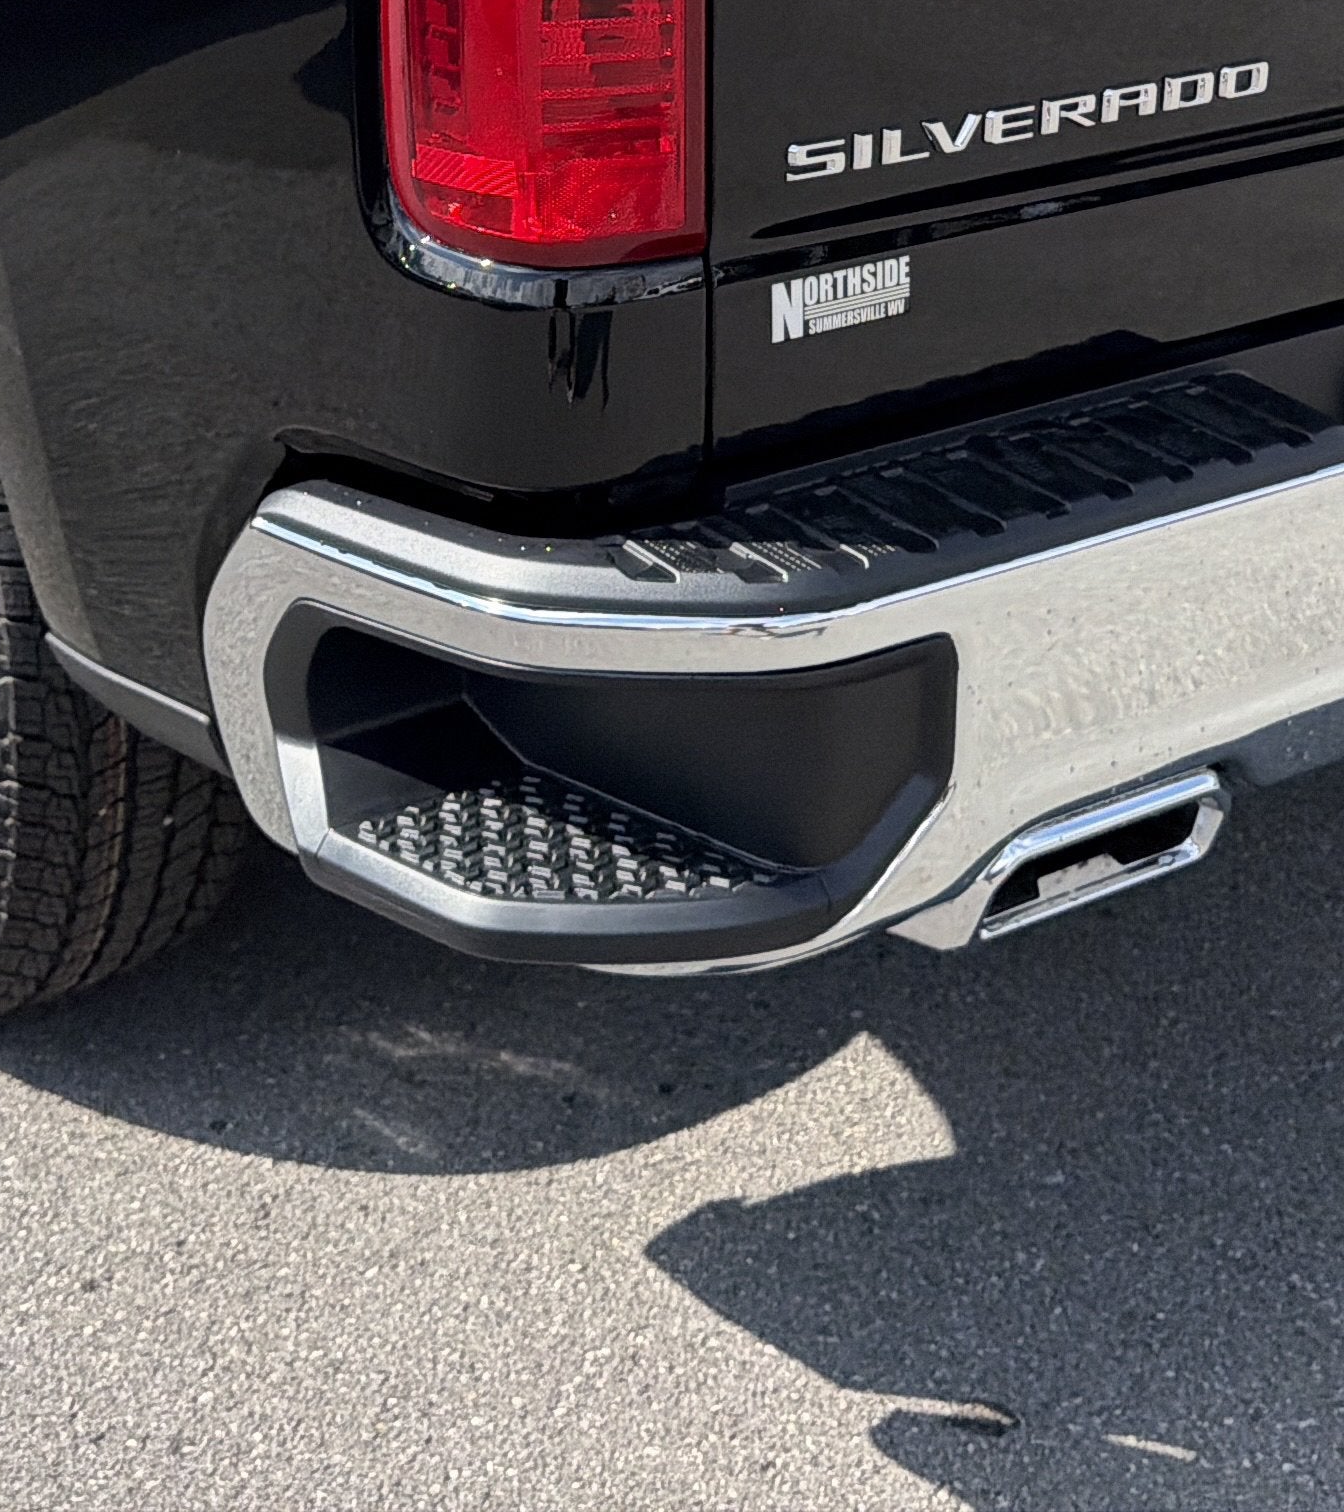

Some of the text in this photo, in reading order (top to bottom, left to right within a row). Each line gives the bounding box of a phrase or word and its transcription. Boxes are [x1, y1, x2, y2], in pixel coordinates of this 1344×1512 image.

[786, 61, 1270, 182] SILVERADO
[771, 255, 911, 344] NORTHSIDE
[808, 298, 905, 335] SUMMERSVILLE WV
